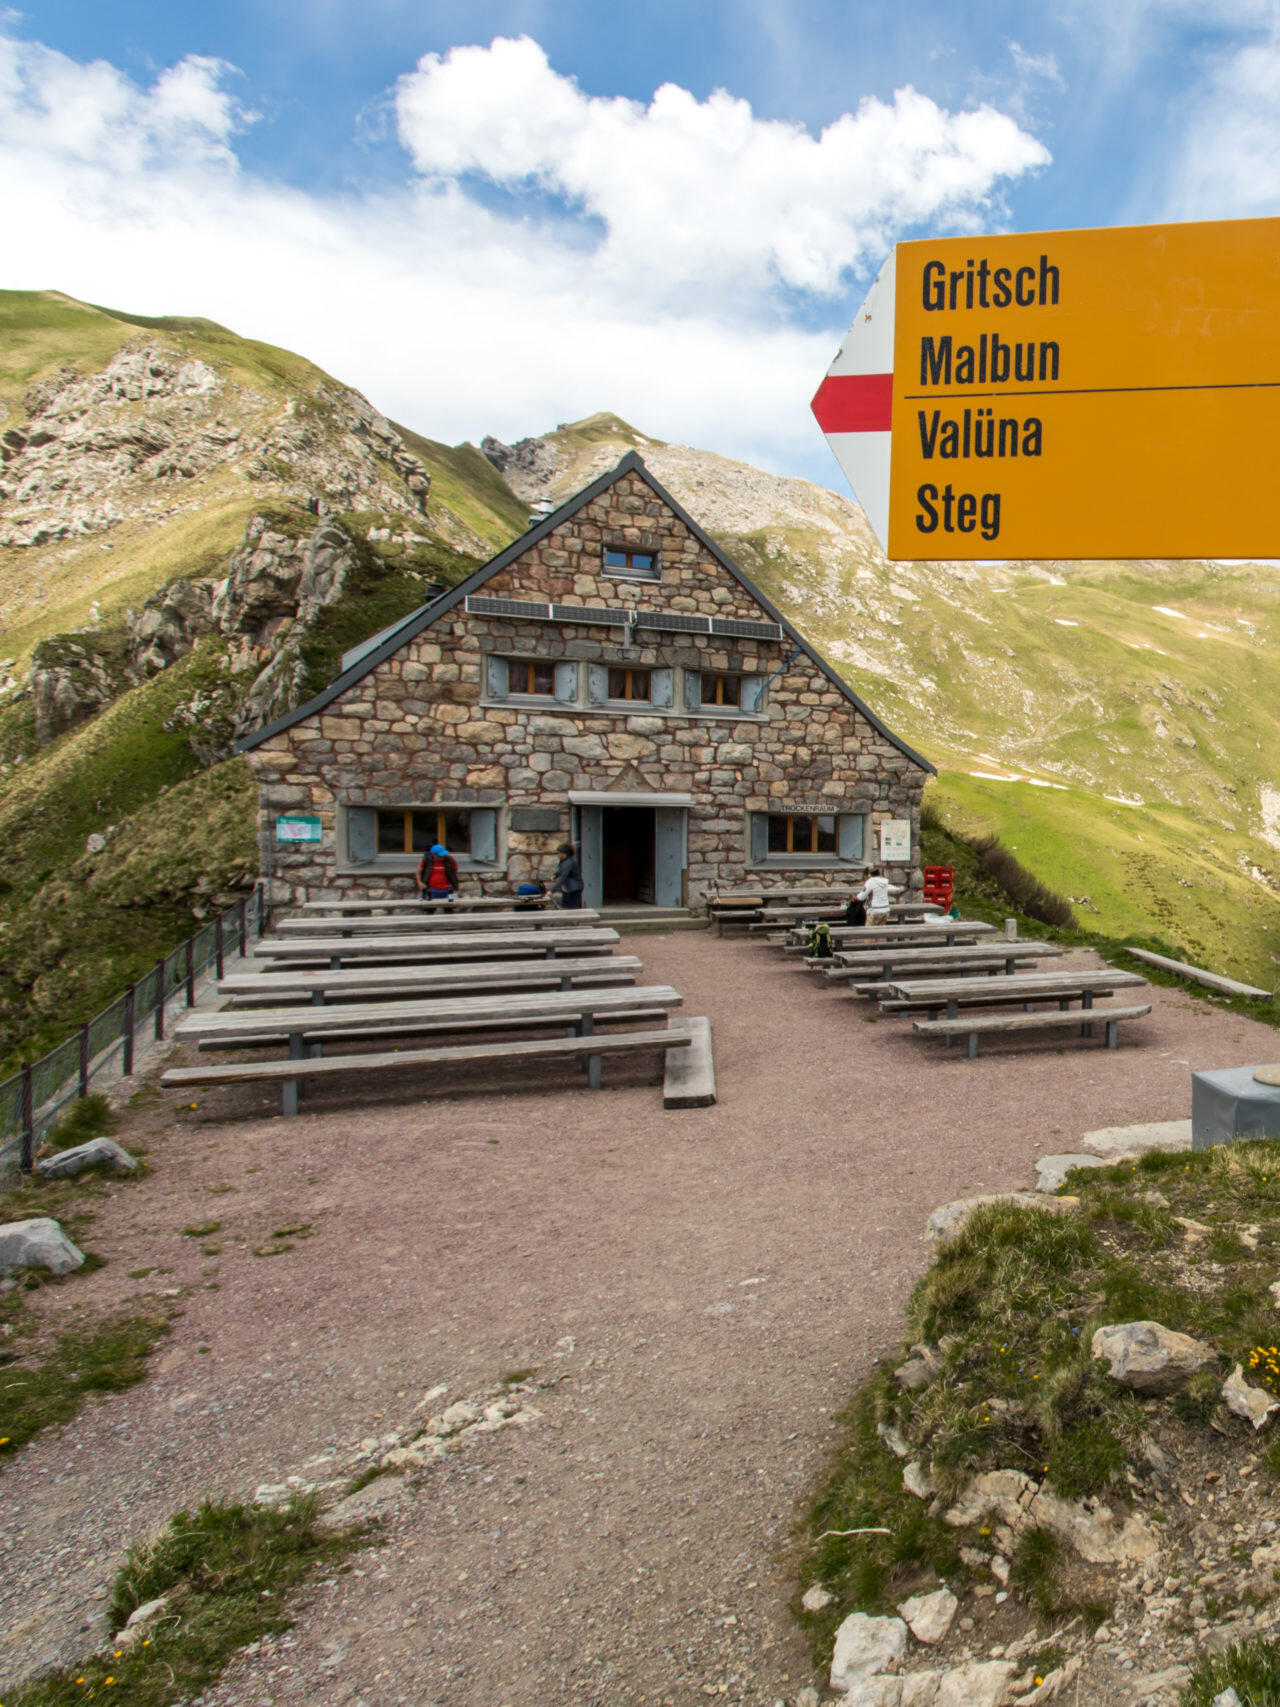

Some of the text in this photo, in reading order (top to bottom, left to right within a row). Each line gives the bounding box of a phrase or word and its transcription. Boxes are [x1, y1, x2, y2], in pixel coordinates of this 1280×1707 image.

[922, 254, 1061, 312] Gritsch
[920, 333, 1060, 386] Malbun
[917, 408, 1043, 460] Valüna
[914, 483, 1002, 542] Steg
